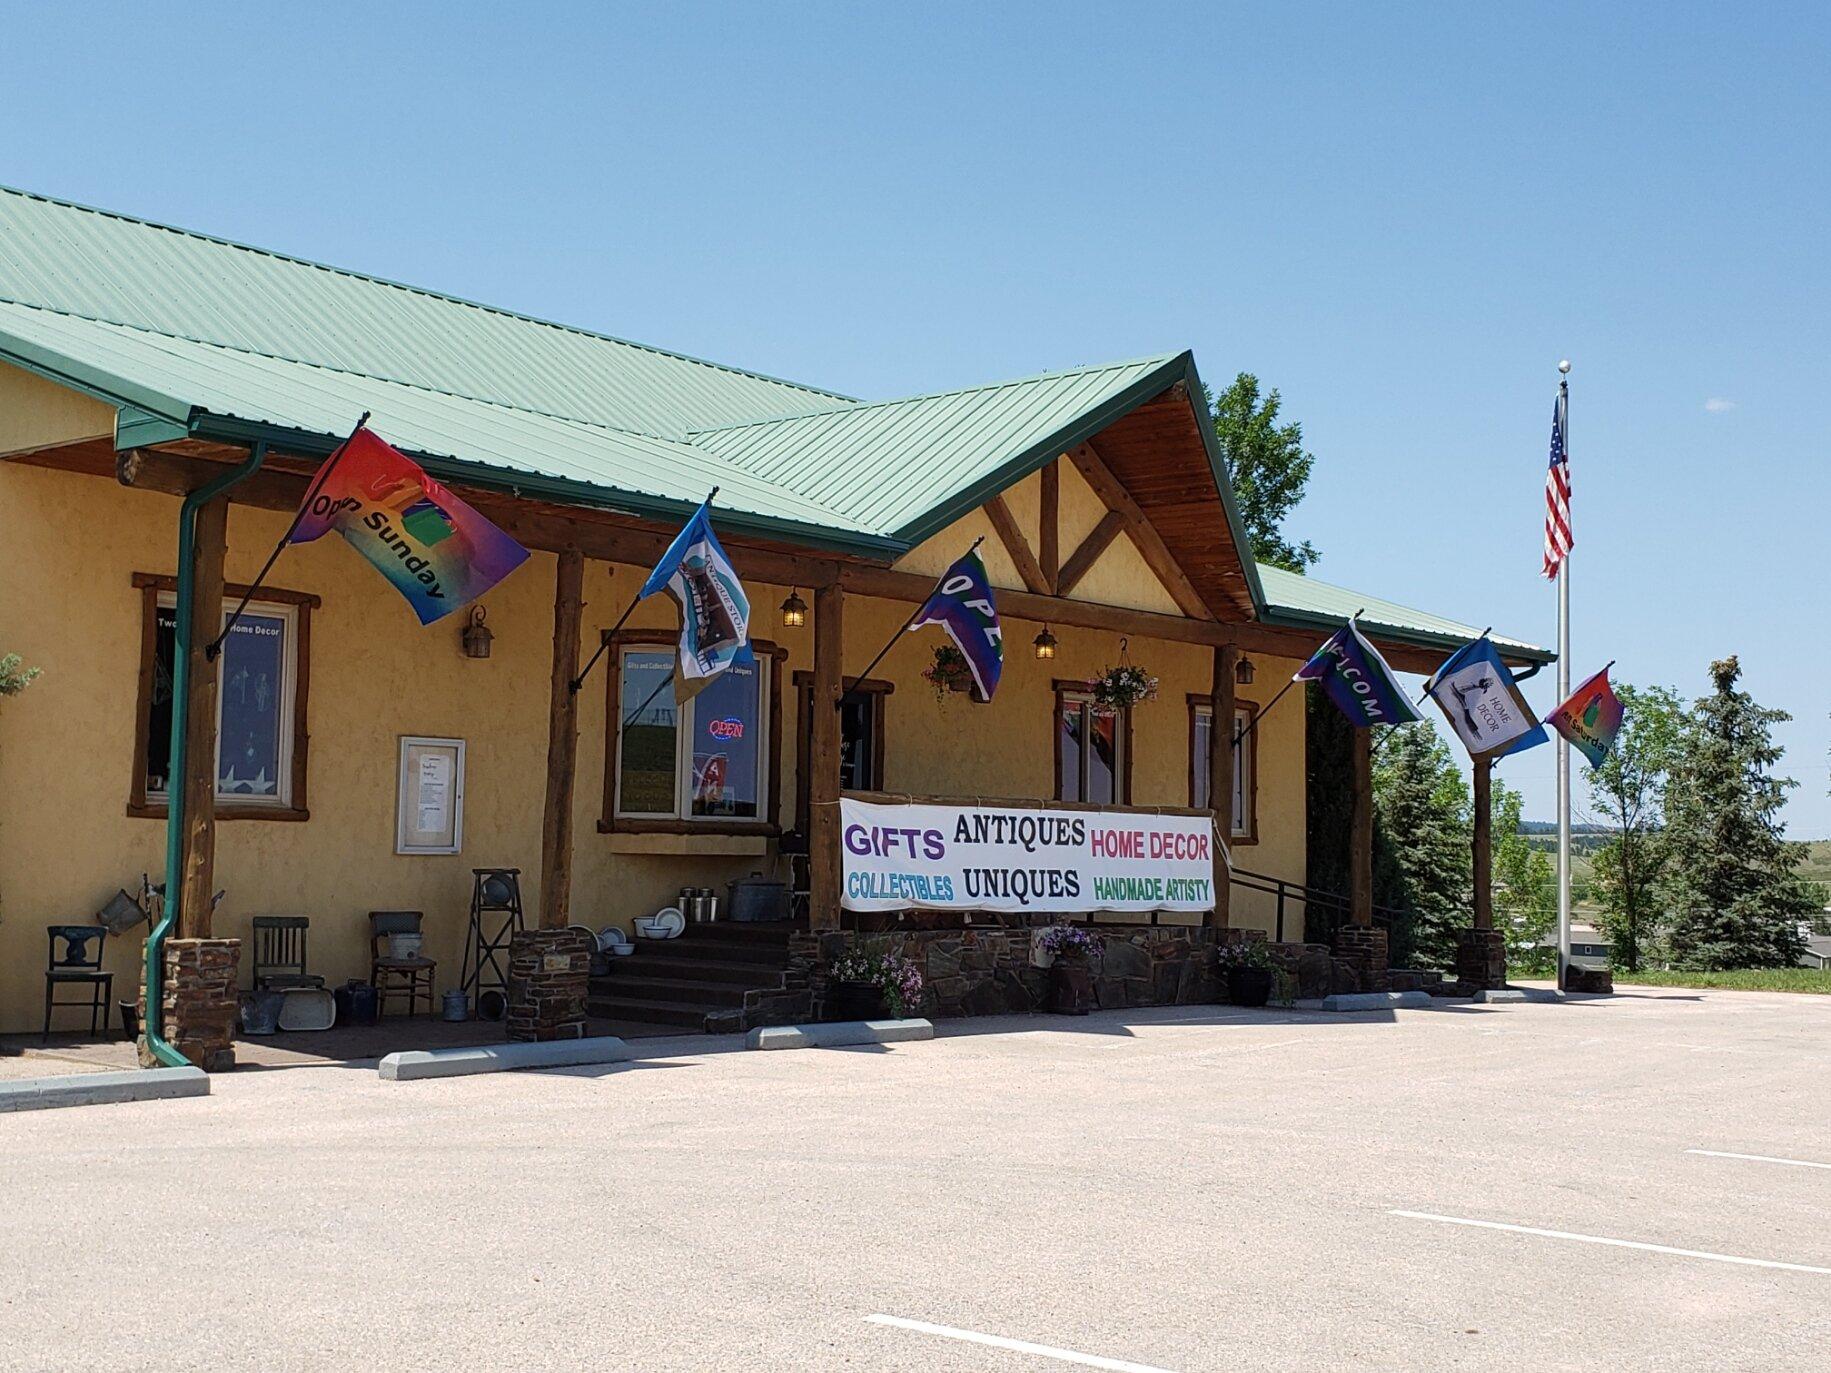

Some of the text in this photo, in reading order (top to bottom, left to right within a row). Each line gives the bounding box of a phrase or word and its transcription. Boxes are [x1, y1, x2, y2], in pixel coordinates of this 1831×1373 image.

[363, 512, 445, 598] Sunday
[230, 624, 279, 636] Home Decor
[942, 575, 1003, 662] OPE
[1327, 642, 1388, 726] ELCOM
[1476, 703, 1500, 732] DECOR
[1489, 697, 1511, 724] HOME
[709, 719, 743, 738] OPEN
[844, 823, 945, 860] GIFTS
[953, 814, 1086, 853] ANTIQUES
[1090, 829, 1209, 861] HOME DECOR
[848, 872, 954, 901] COLLECTIBLES
[962, 868, 1080, 906] UNIQUES
[1093, 877, 1209, 901] HANDMADE ARTISTY
